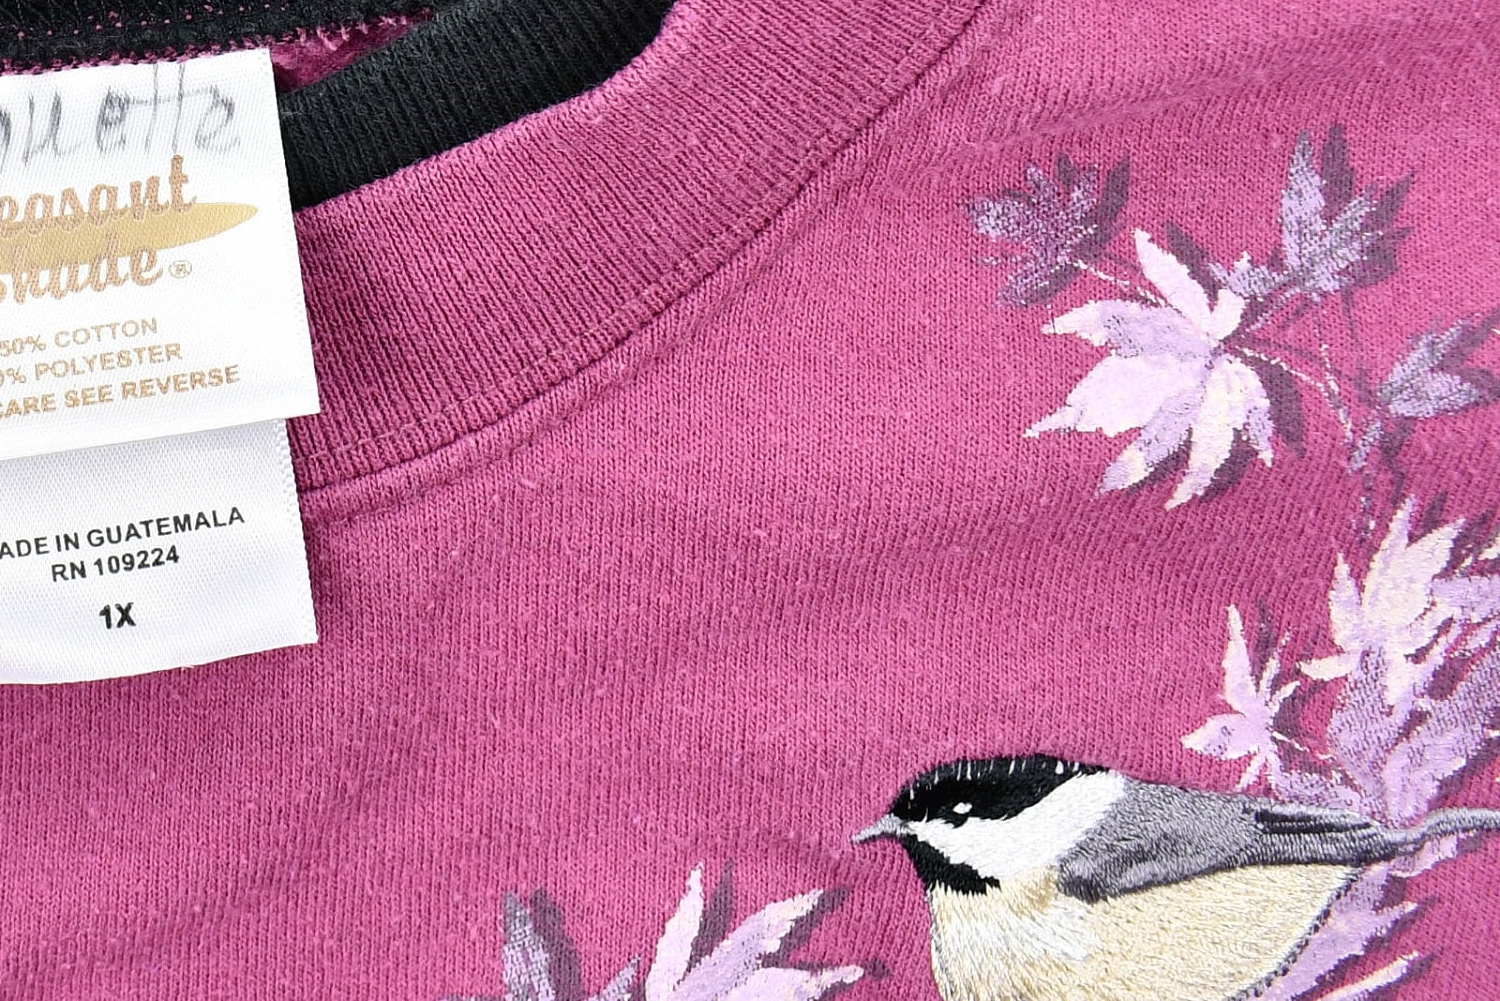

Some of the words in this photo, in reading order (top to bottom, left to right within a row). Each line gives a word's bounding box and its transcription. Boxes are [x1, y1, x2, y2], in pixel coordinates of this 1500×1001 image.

[54, 317, 159, 348] COTTON
[34, 342, 183, 381] POLYESTER
[64, 385, 116, 410] SEE
[121, 364, 242, 402] REVERSE
[54, 531, 81, 554] IN
[86, 506, 246, 549] GUATEMALA
[50, 560, 88, 583] RN
[93, 544, 181, 577] 109224
[98, 602, 138, 630] 1X
